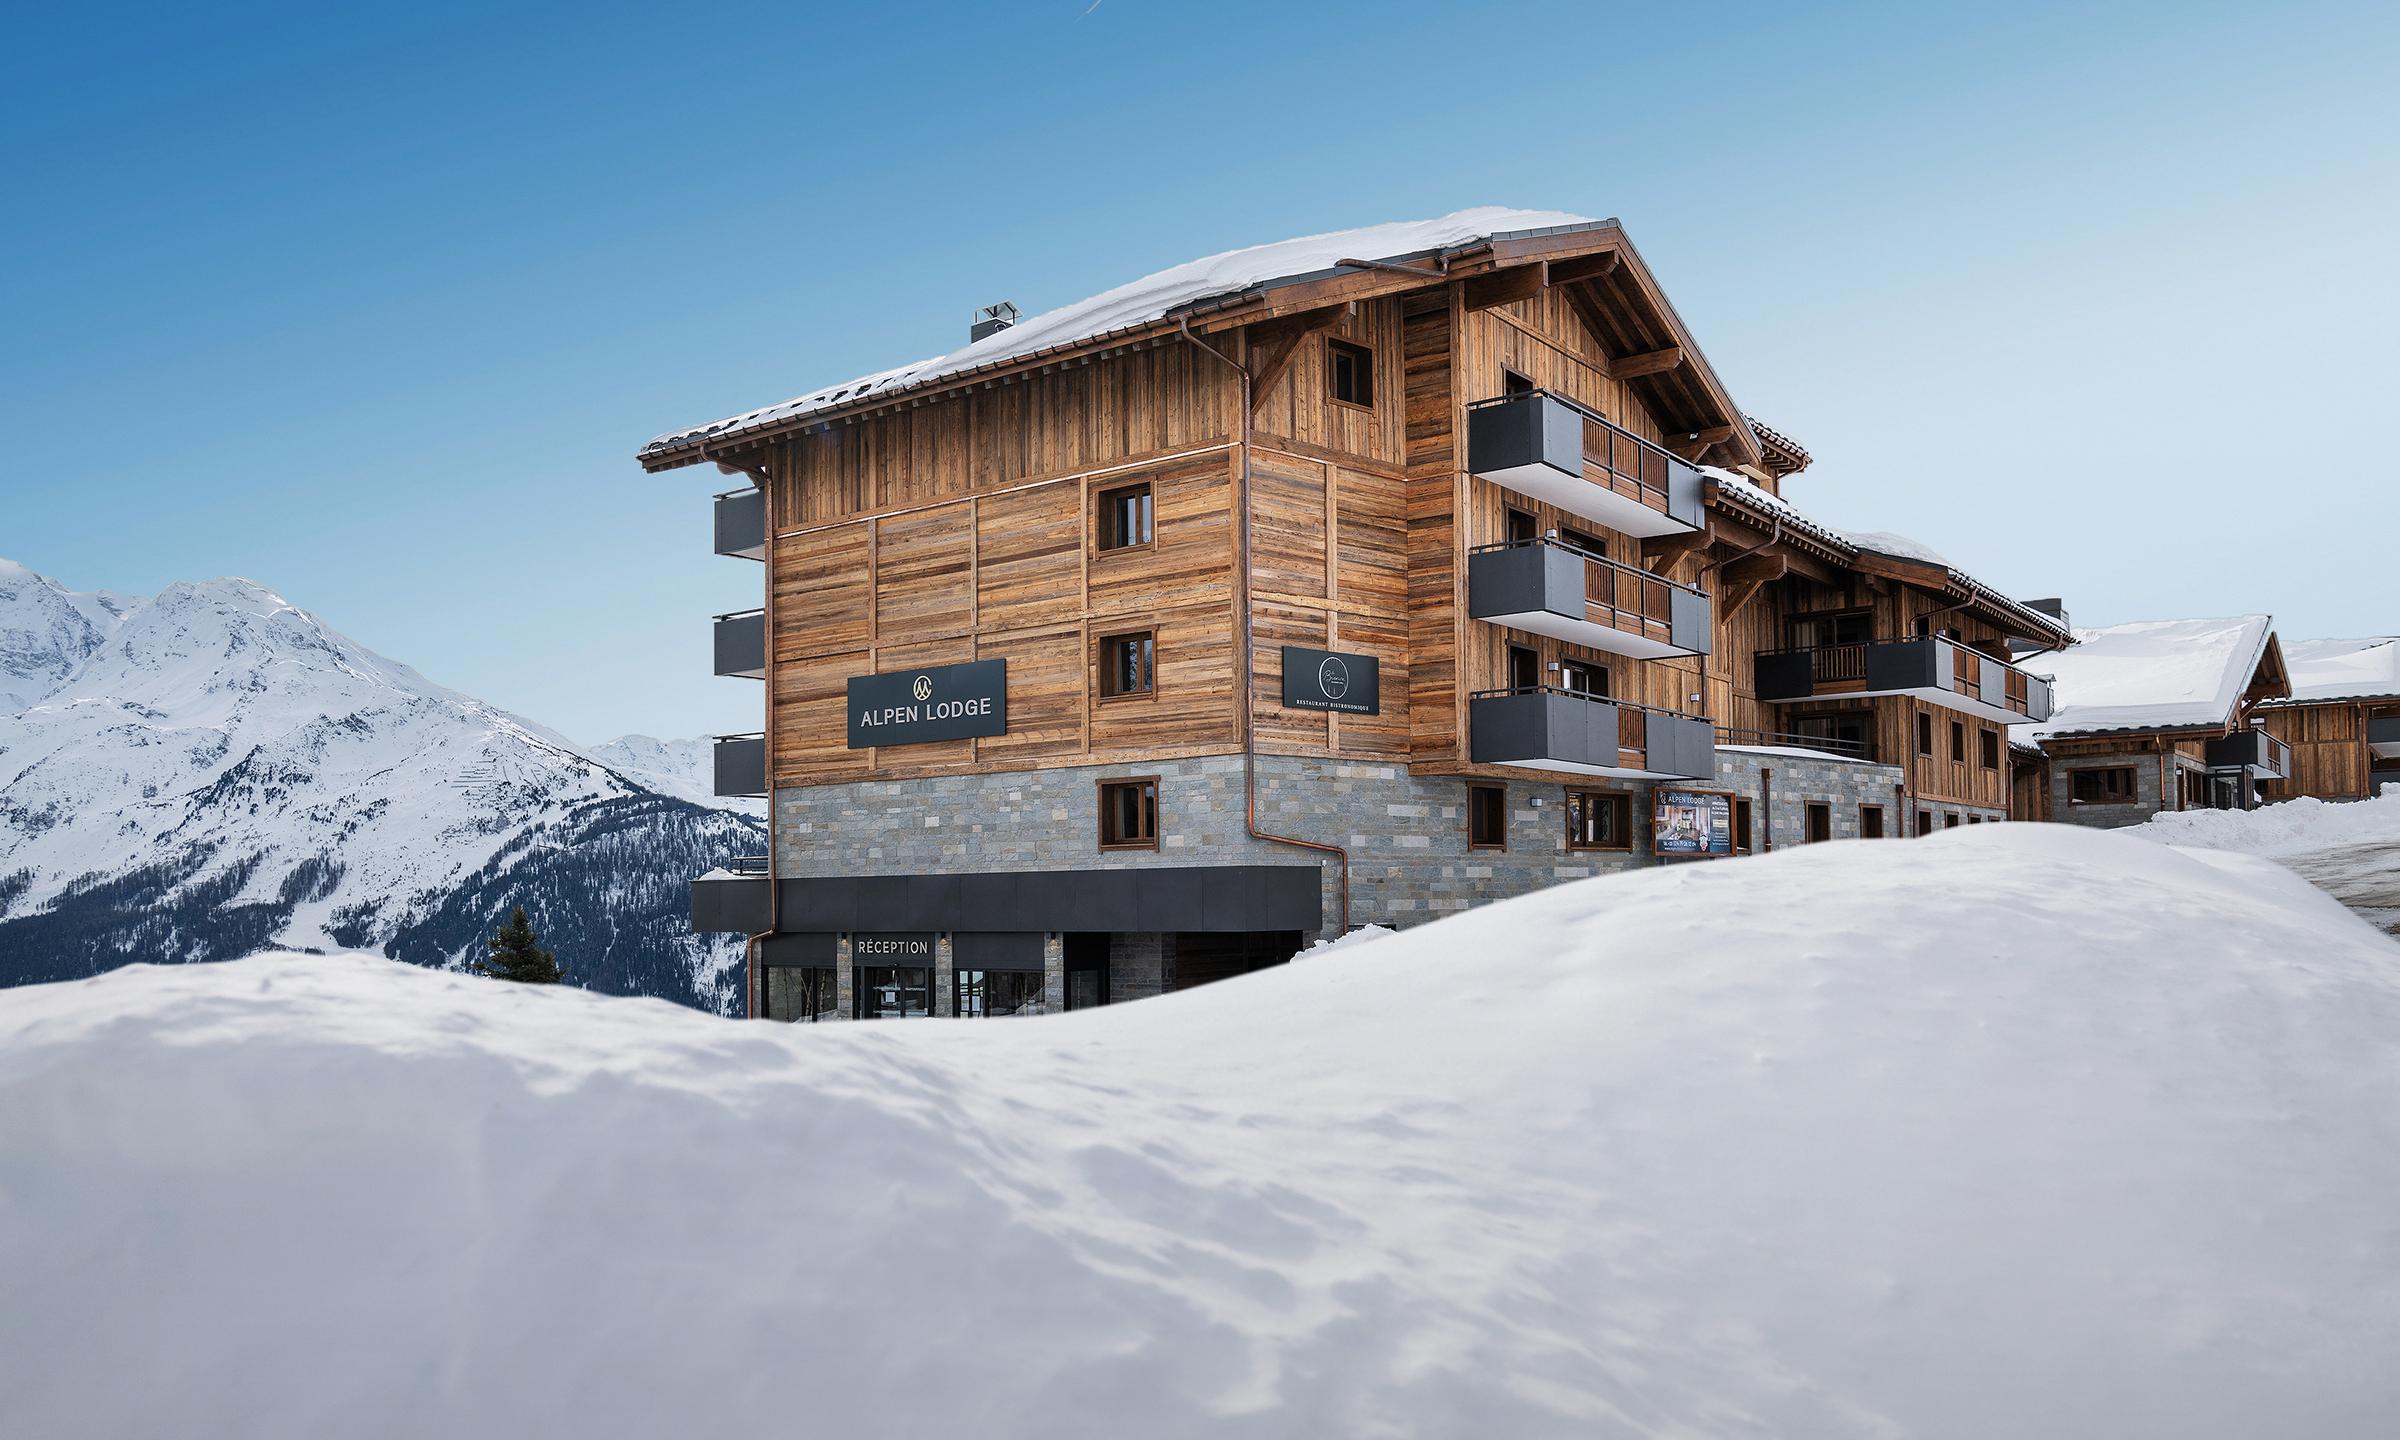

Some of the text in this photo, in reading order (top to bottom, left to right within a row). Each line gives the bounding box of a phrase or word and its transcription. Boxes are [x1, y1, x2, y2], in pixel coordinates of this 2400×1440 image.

[1296, 699, 1368, 711] RESTAURANT BISTRONOMIQUE
[860, 697, 992, 728] ALPEN LODGE
[1667, 795, 1686, 804] ALPEN
[1687, 796, 1705, 805] LODGE
[858, 938, 928, 954] RÉCEPTION
